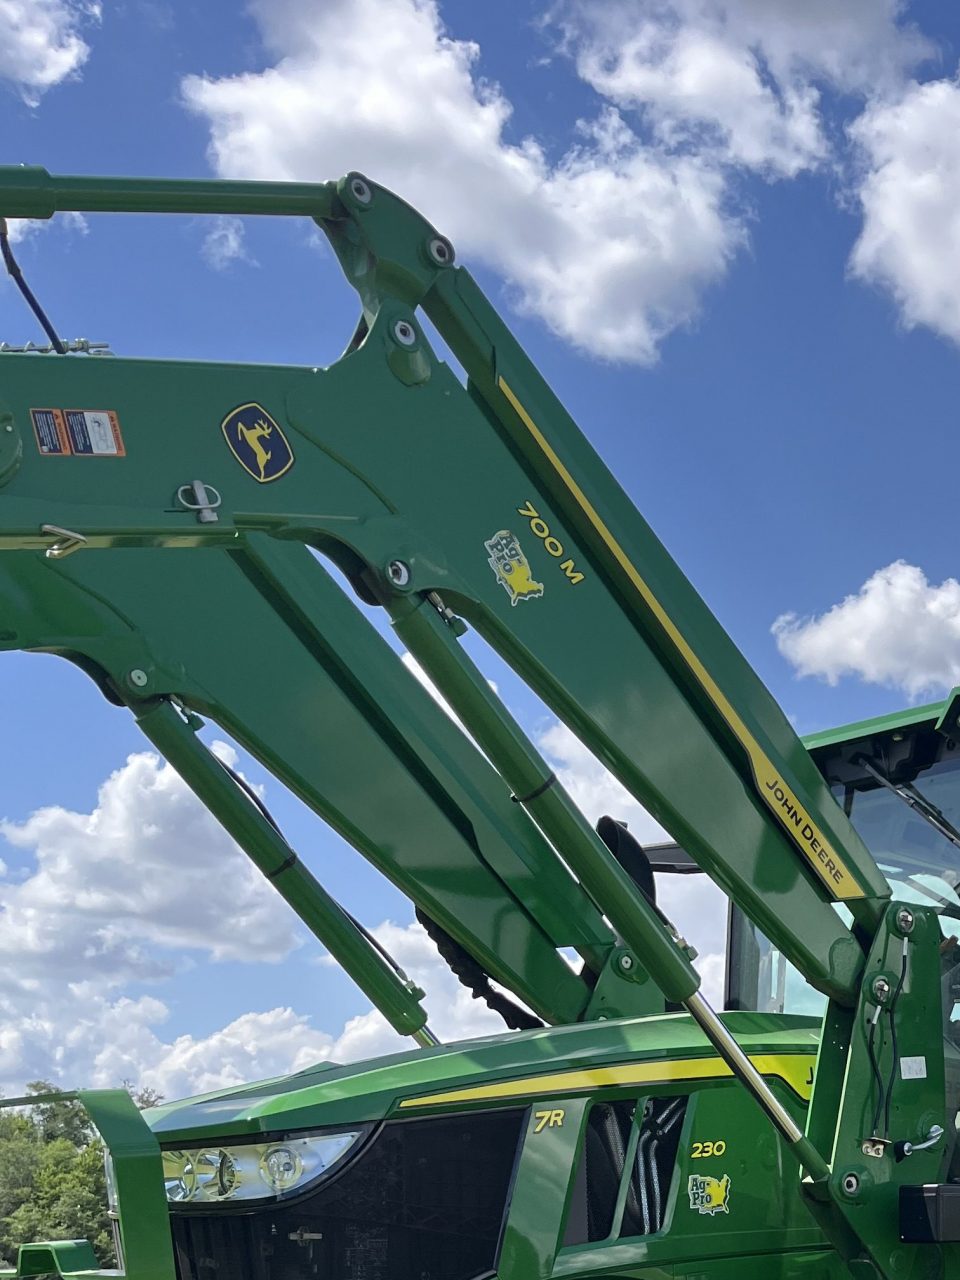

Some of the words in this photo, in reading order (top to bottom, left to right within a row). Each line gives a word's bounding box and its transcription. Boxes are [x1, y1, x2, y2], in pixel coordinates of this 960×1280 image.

[517, 499, 565, 558] 700
[559, 558, 586, 586] M
[490, 541, 515, 575] Pro
[765, 779, 803, 827] JOHN
[800, 824, 845, 885] DEERE
[533, 1108, 566, 1135] 7R
[690, 1139, 727, 1160] 230
[691, 1191, 713, 1206] Pro
